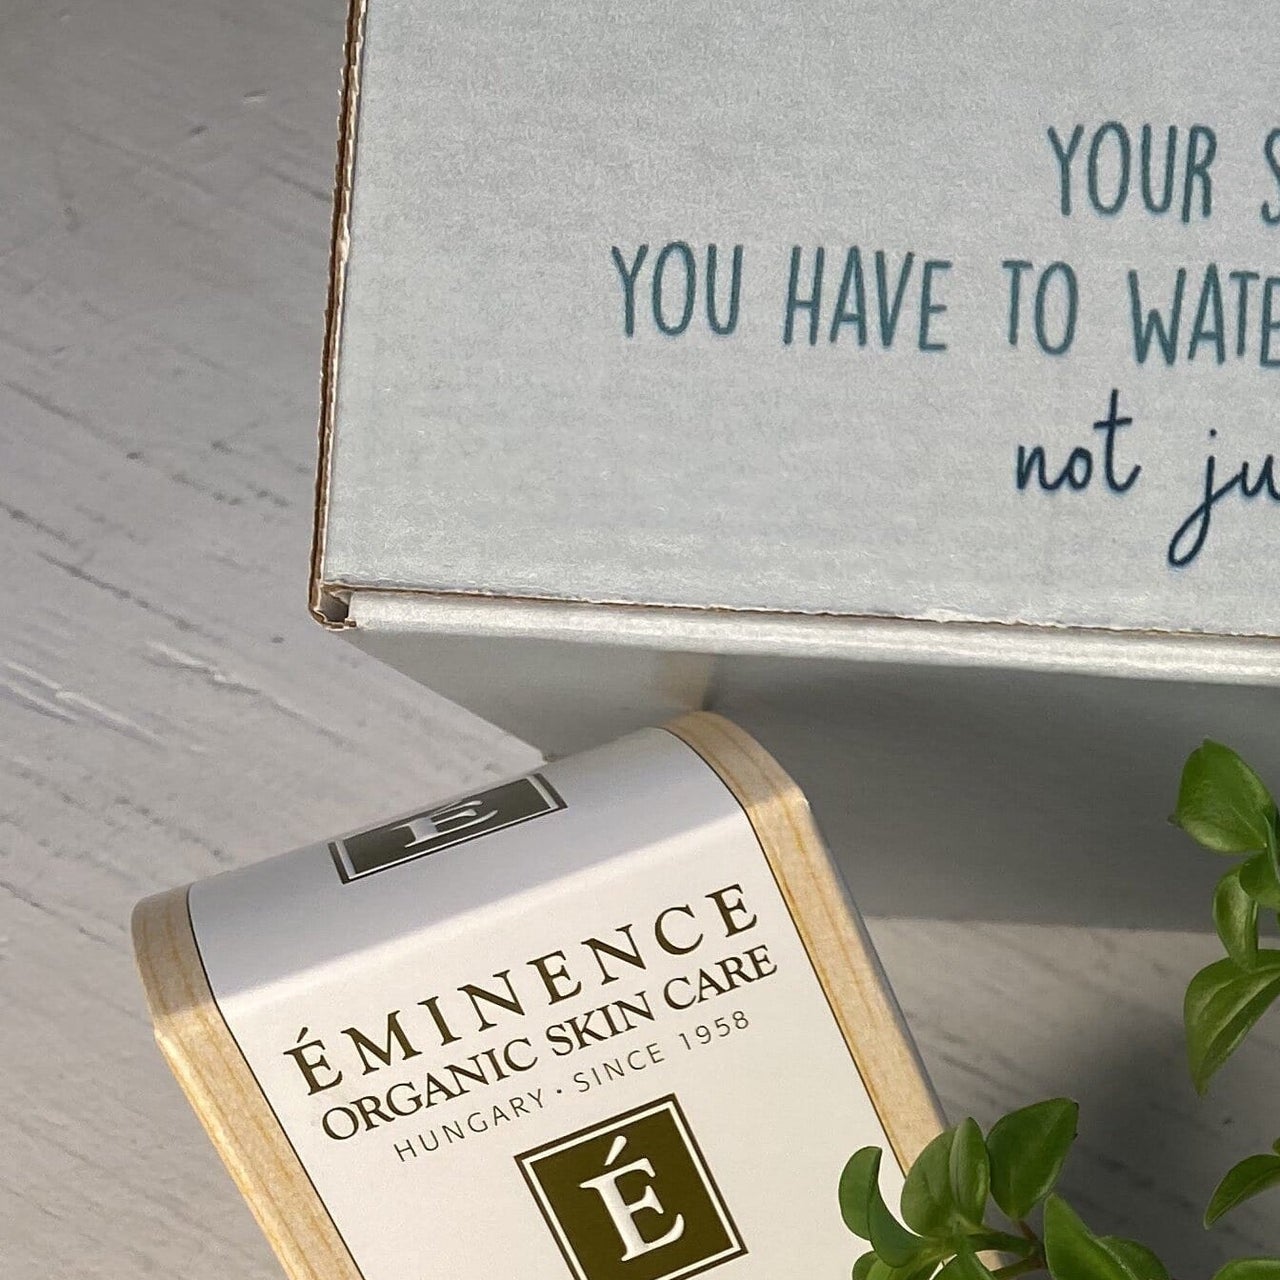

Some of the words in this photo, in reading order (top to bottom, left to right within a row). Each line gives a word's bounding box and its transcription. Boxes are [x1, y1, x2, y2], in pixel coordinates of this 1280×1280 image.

[1047, 121, 1217, 224] YOUR
[610, 241, 745, 338] YOU
[781, 246, 953, 353] HAVE
[1001, 260, 1081, 356] TO
[1014, 389, 1142, 494] not
[284, 884, 758, 1096] ÉMINENCE
[322, 1038, 538, 1141] ORGANIC
[547, 991, 655, 1056] SKIN
[662, 944, 778, 1010] CARE
[393, 1089, 545, 1162] HUNGARY
[573, 1042, 666, 1093] SINCE
[679, 1009, 750, 1051] 1958
[580, 1135, 685, 1261] É
